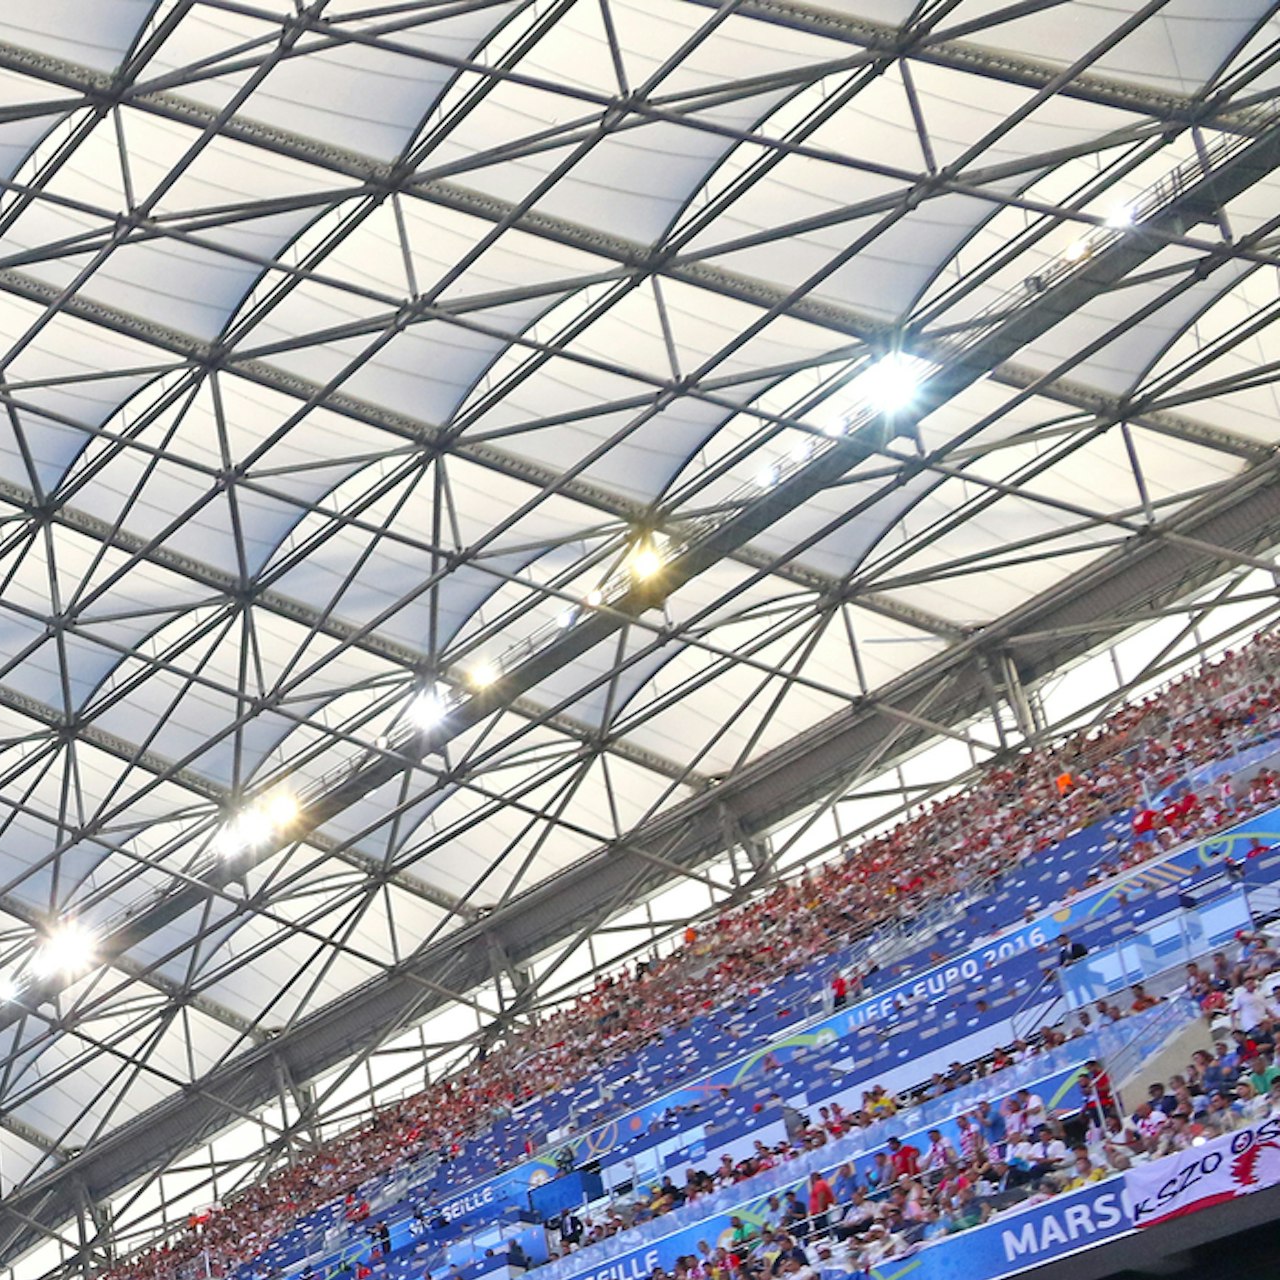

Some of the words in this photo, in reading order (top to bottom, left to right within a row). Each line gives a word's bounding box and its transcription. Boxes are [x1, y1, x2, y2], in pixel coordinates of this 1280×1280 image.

[913, 958, 978, 999] EURO
[1133, 1151, 1223, 1222] KSZO
[1001, 1188, 1130, 1262] MARS
